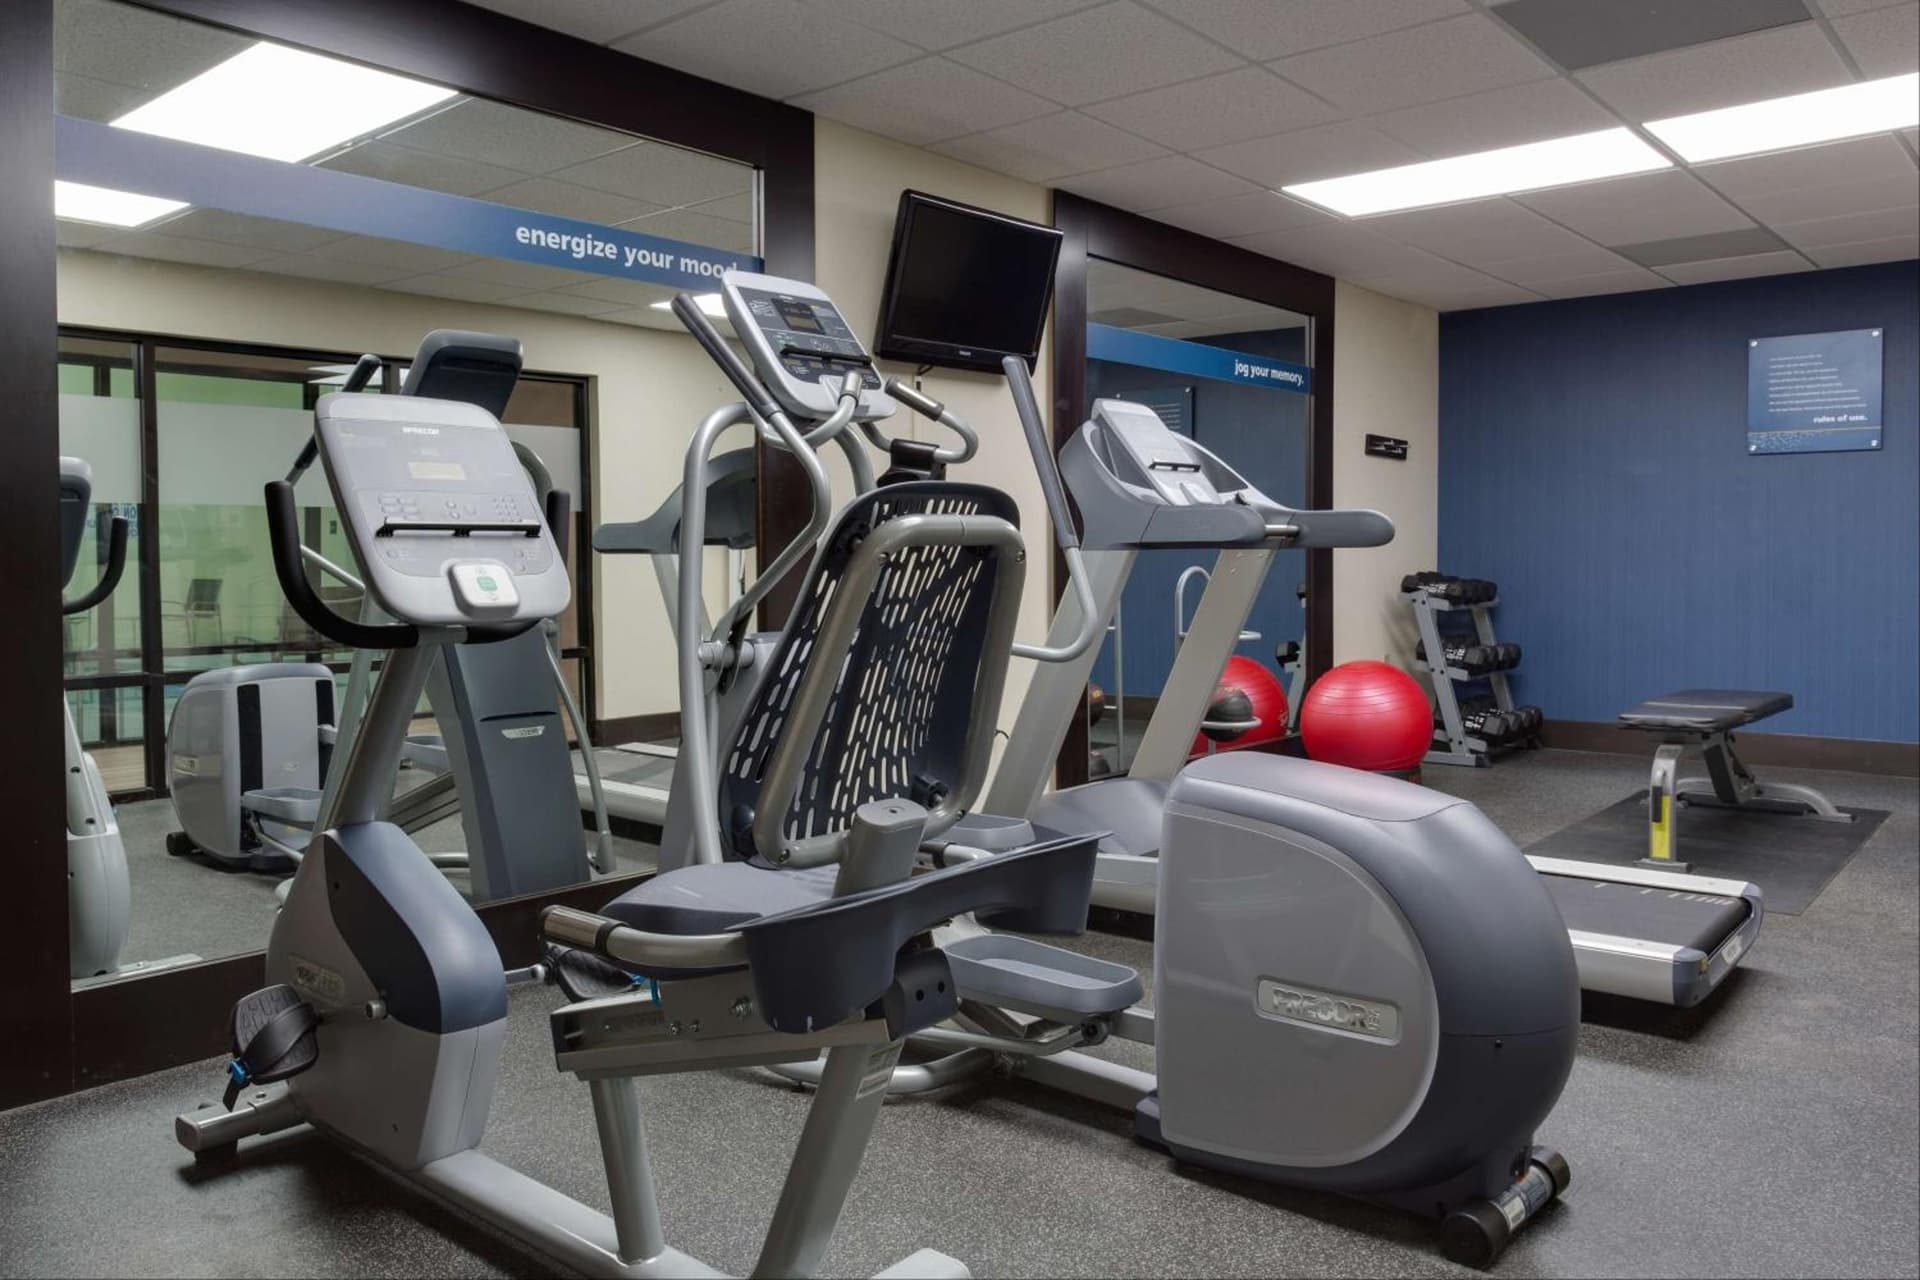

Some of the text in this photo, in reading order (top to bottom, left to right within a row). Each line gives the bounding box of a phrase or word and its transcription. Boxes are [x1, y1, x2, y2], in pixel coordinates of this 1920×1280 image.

[515, 226, 618, 259] energize
[623, 244, 674, 267] your
[1234, 358, 1304, 386] jog your memory.
[1837, 414, 1848, 422] of
